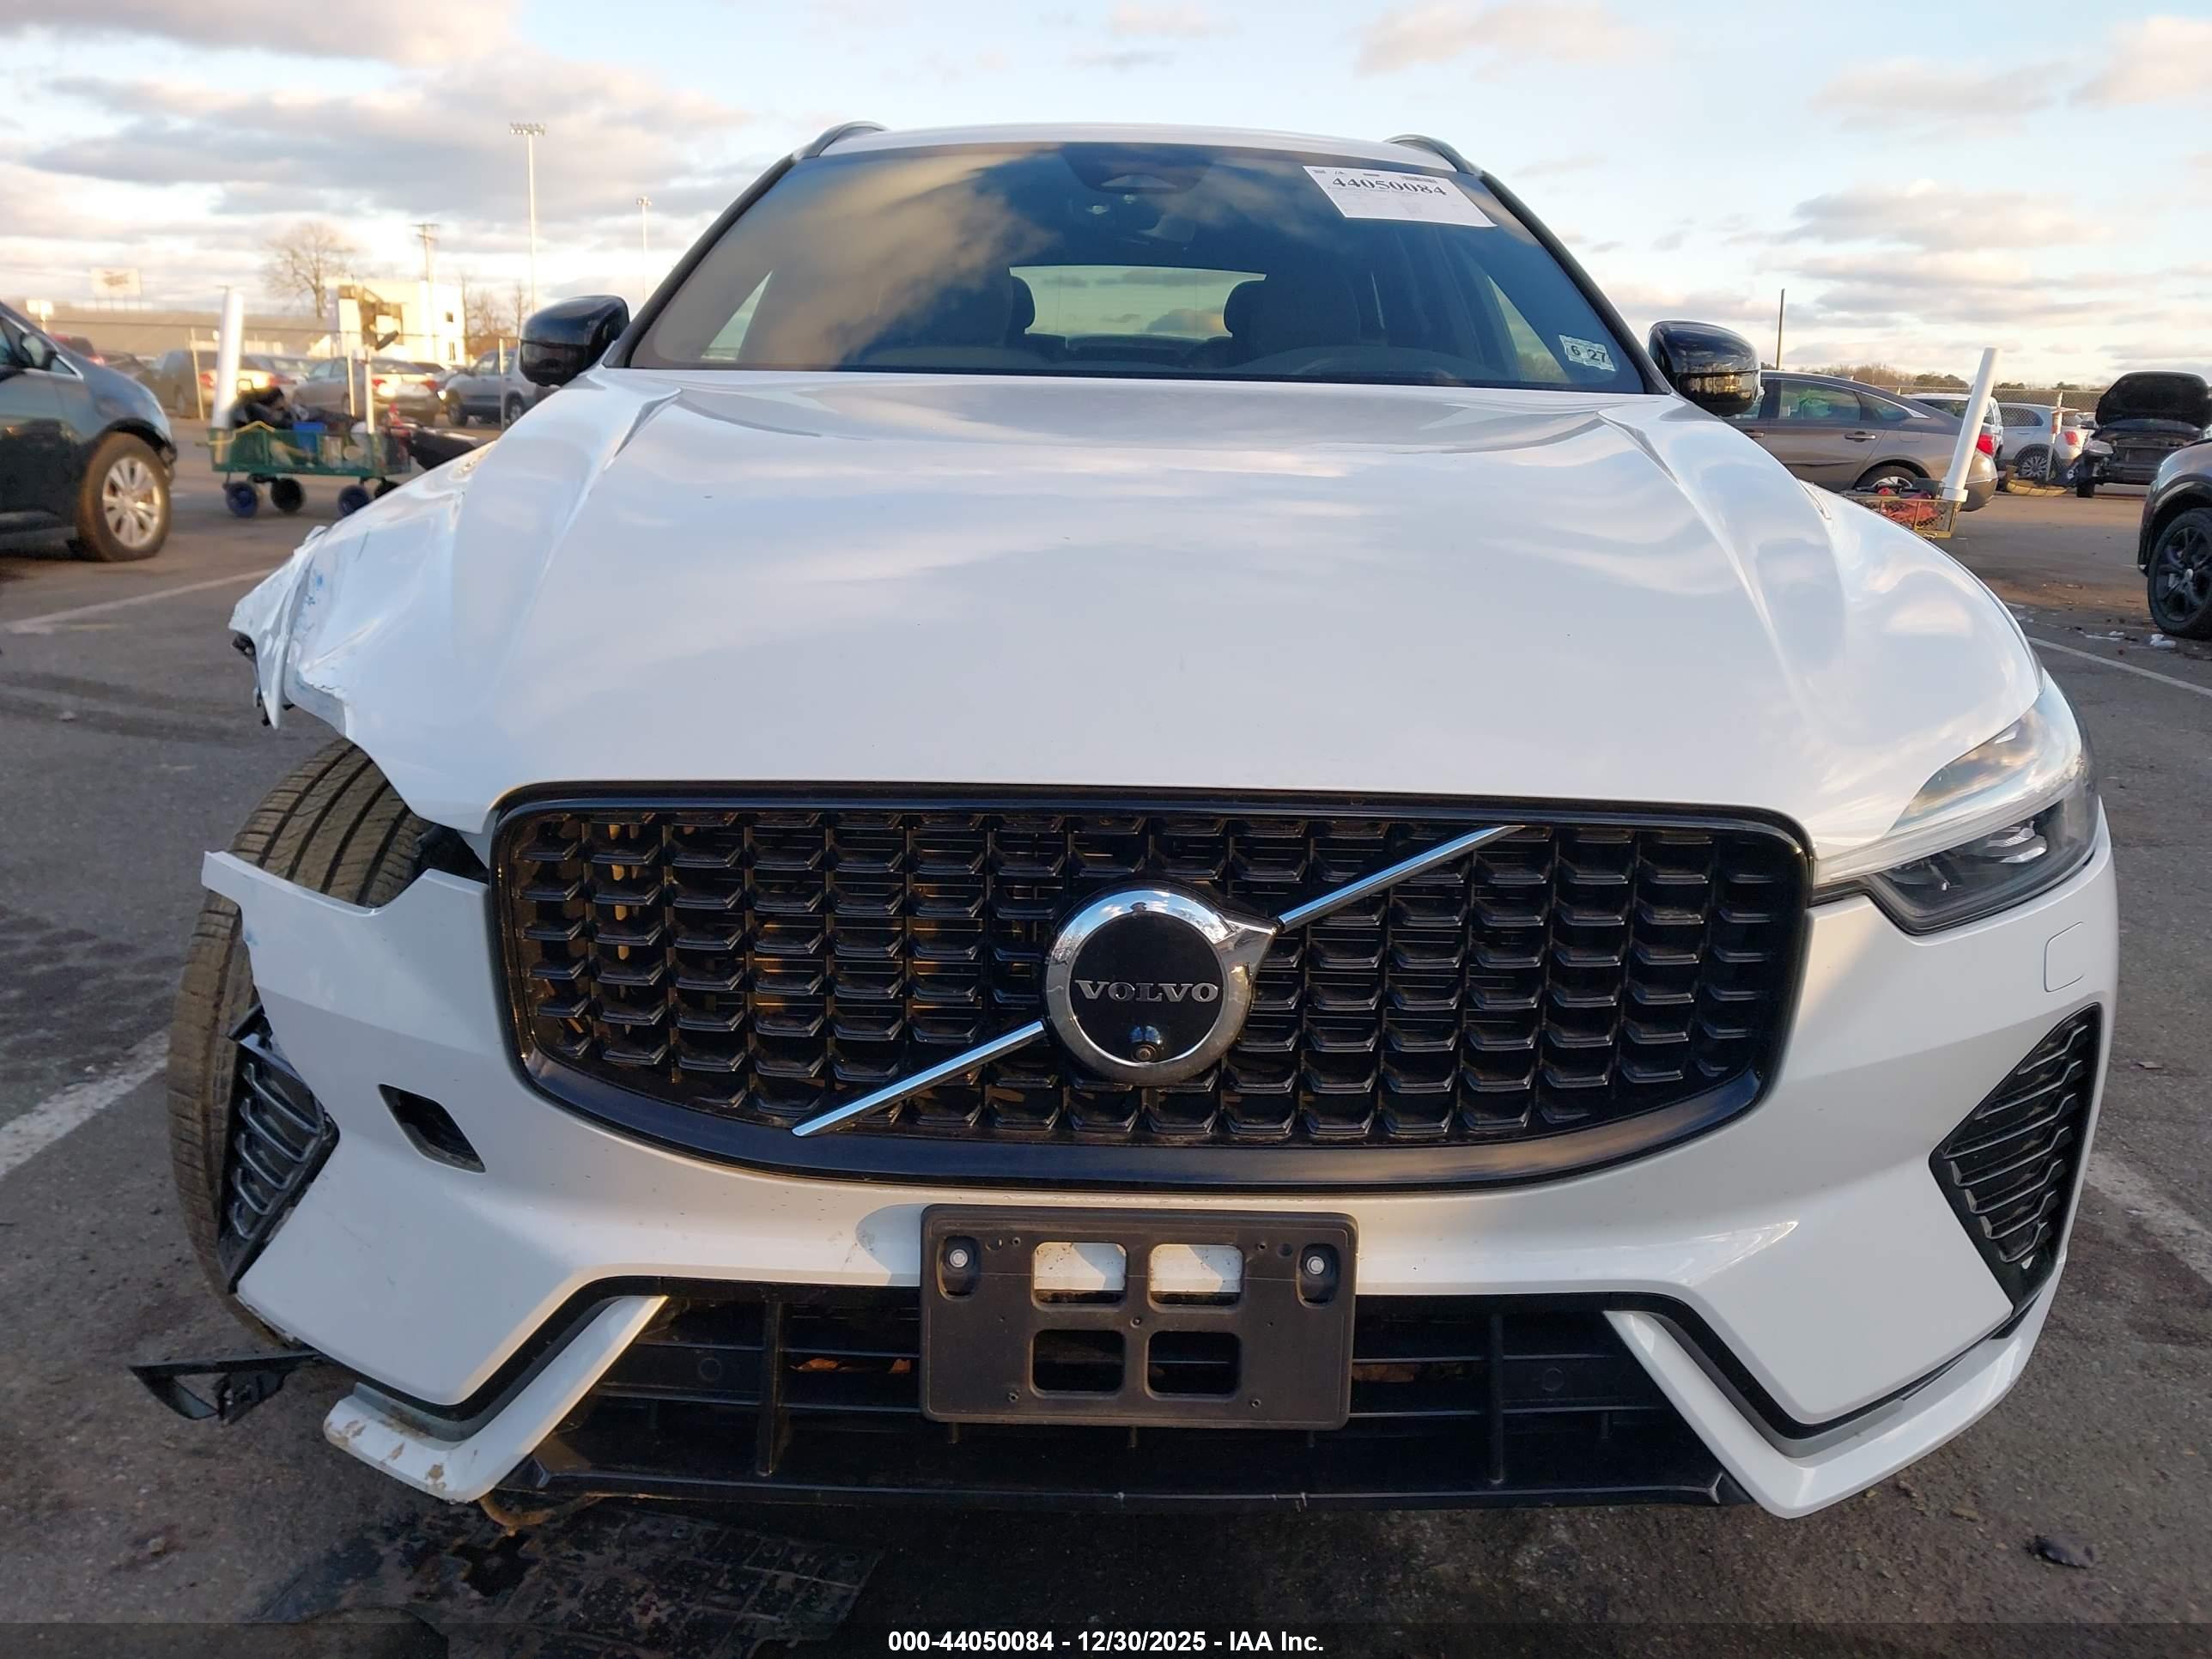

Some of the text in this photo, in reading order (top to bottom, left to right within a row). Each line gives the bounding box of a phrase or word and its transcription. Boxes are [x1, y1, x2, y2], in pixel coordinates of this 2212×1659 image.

[1332, 177, 1448, 196] 44050084
[1571, 345, 1581, 356] 6
[1073, 980, 1219, 1003] VOLVO
